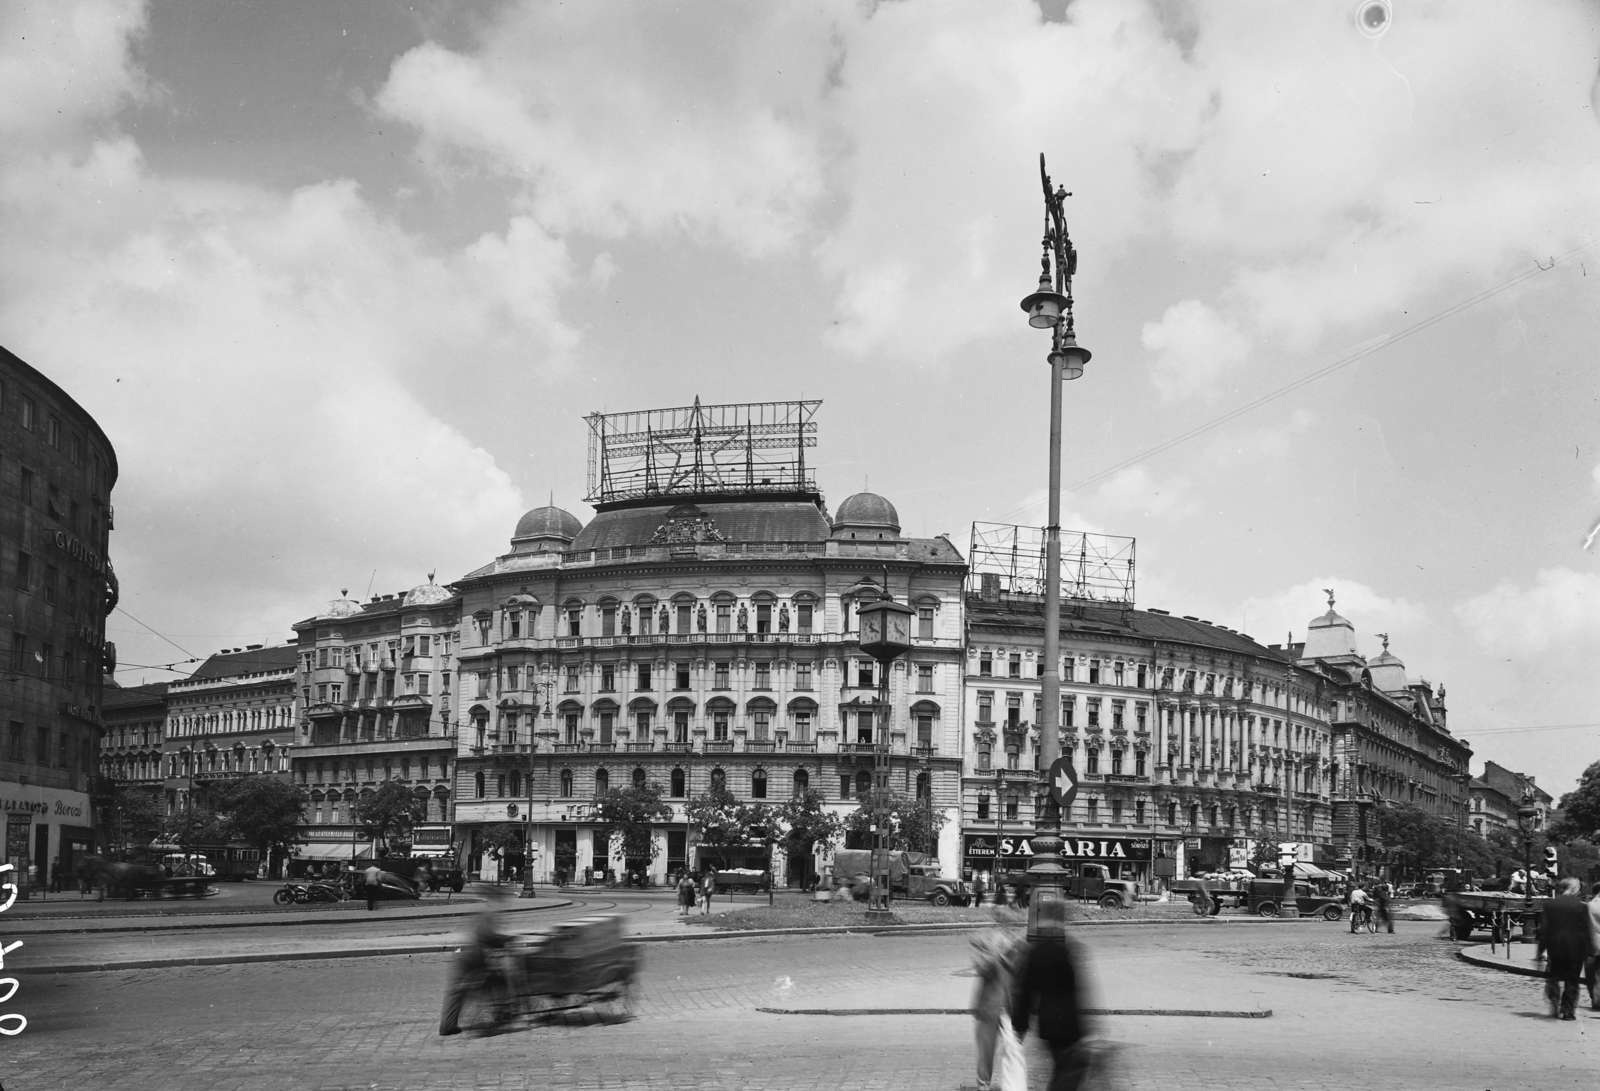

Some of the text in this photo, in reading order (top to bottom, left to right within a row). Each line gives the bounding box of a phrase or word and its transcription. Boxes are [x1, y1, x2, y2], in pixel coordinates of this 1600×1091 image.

[54, 799, 83, 817] Borozó
[968, 846, 995, 855] ÉTTEREM
[1001, 838, 1127, 857] SAARIA
